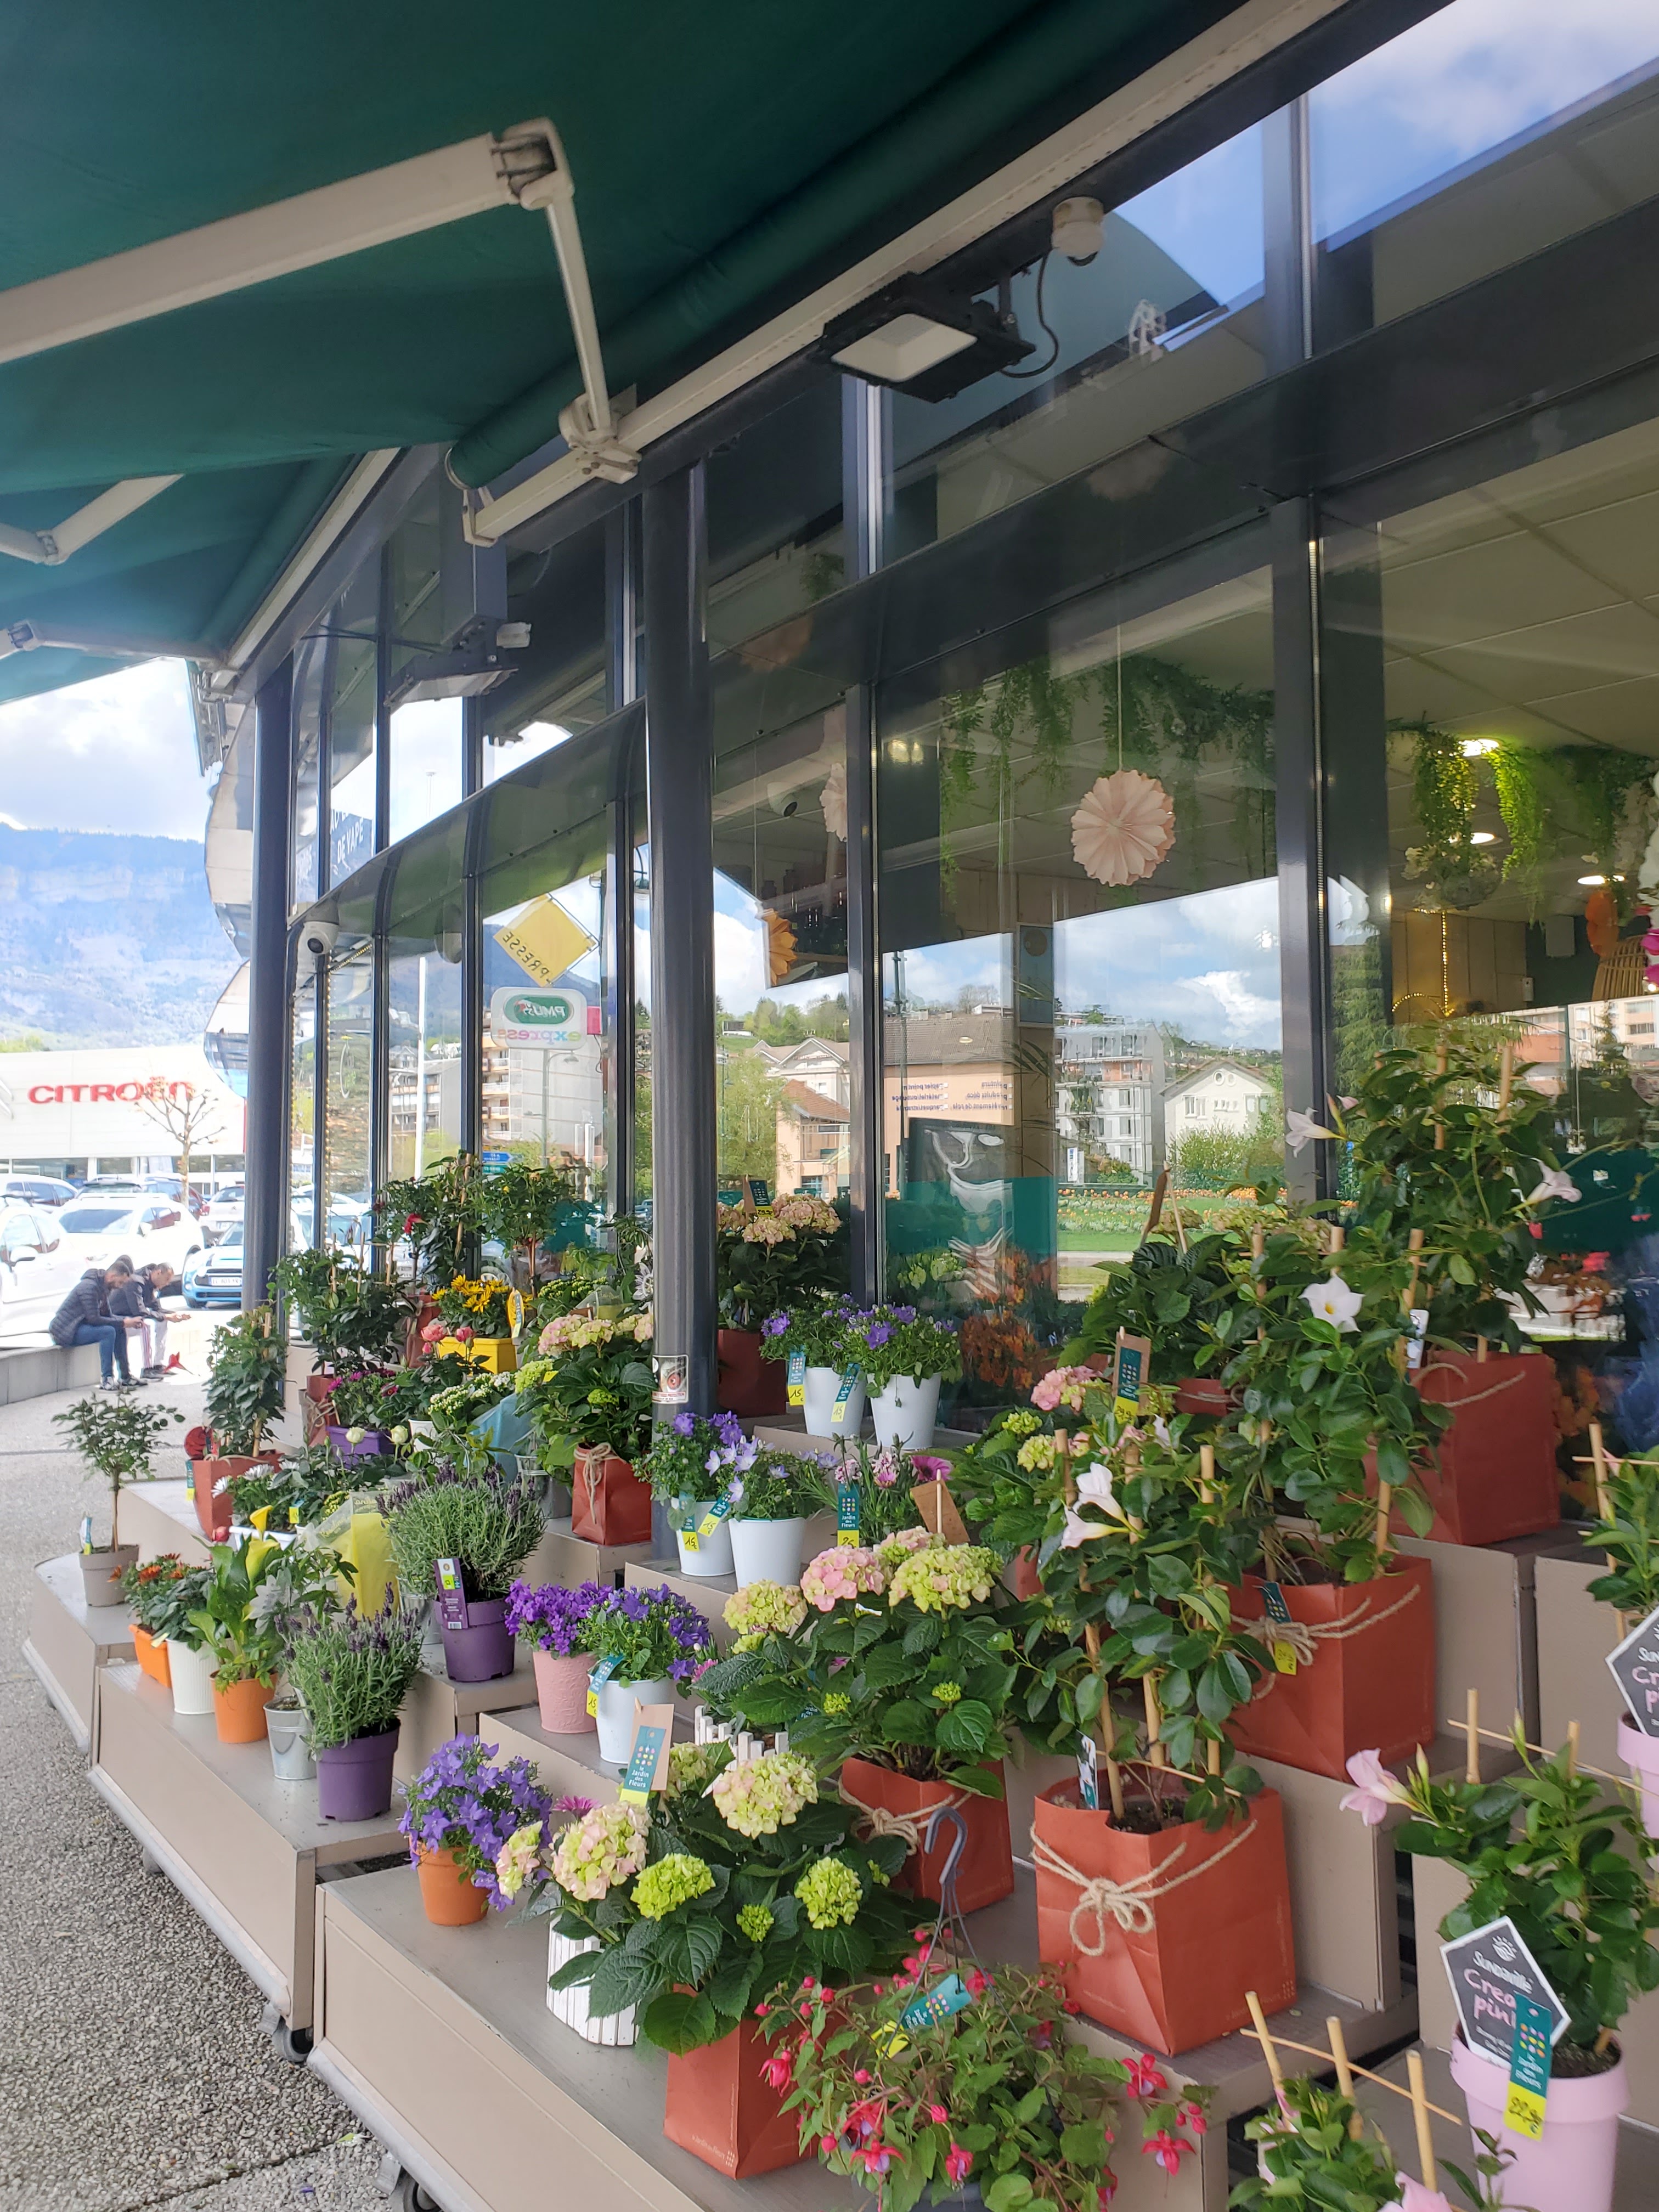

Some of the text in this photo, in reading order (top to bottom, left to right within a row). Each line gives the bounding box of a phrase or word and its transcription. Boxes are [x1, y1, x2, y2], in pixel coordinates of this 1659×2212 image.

[790, 1389, 802, 1399] 15
[834, 1405, 843, 1415] 15
[685, 1537, 695, 1547] 15
[589, 1697, 596, 1708] 15
[631, 1769, 649, 1778] Jardin
[629, 1779, 646, 1788] Fleurs
